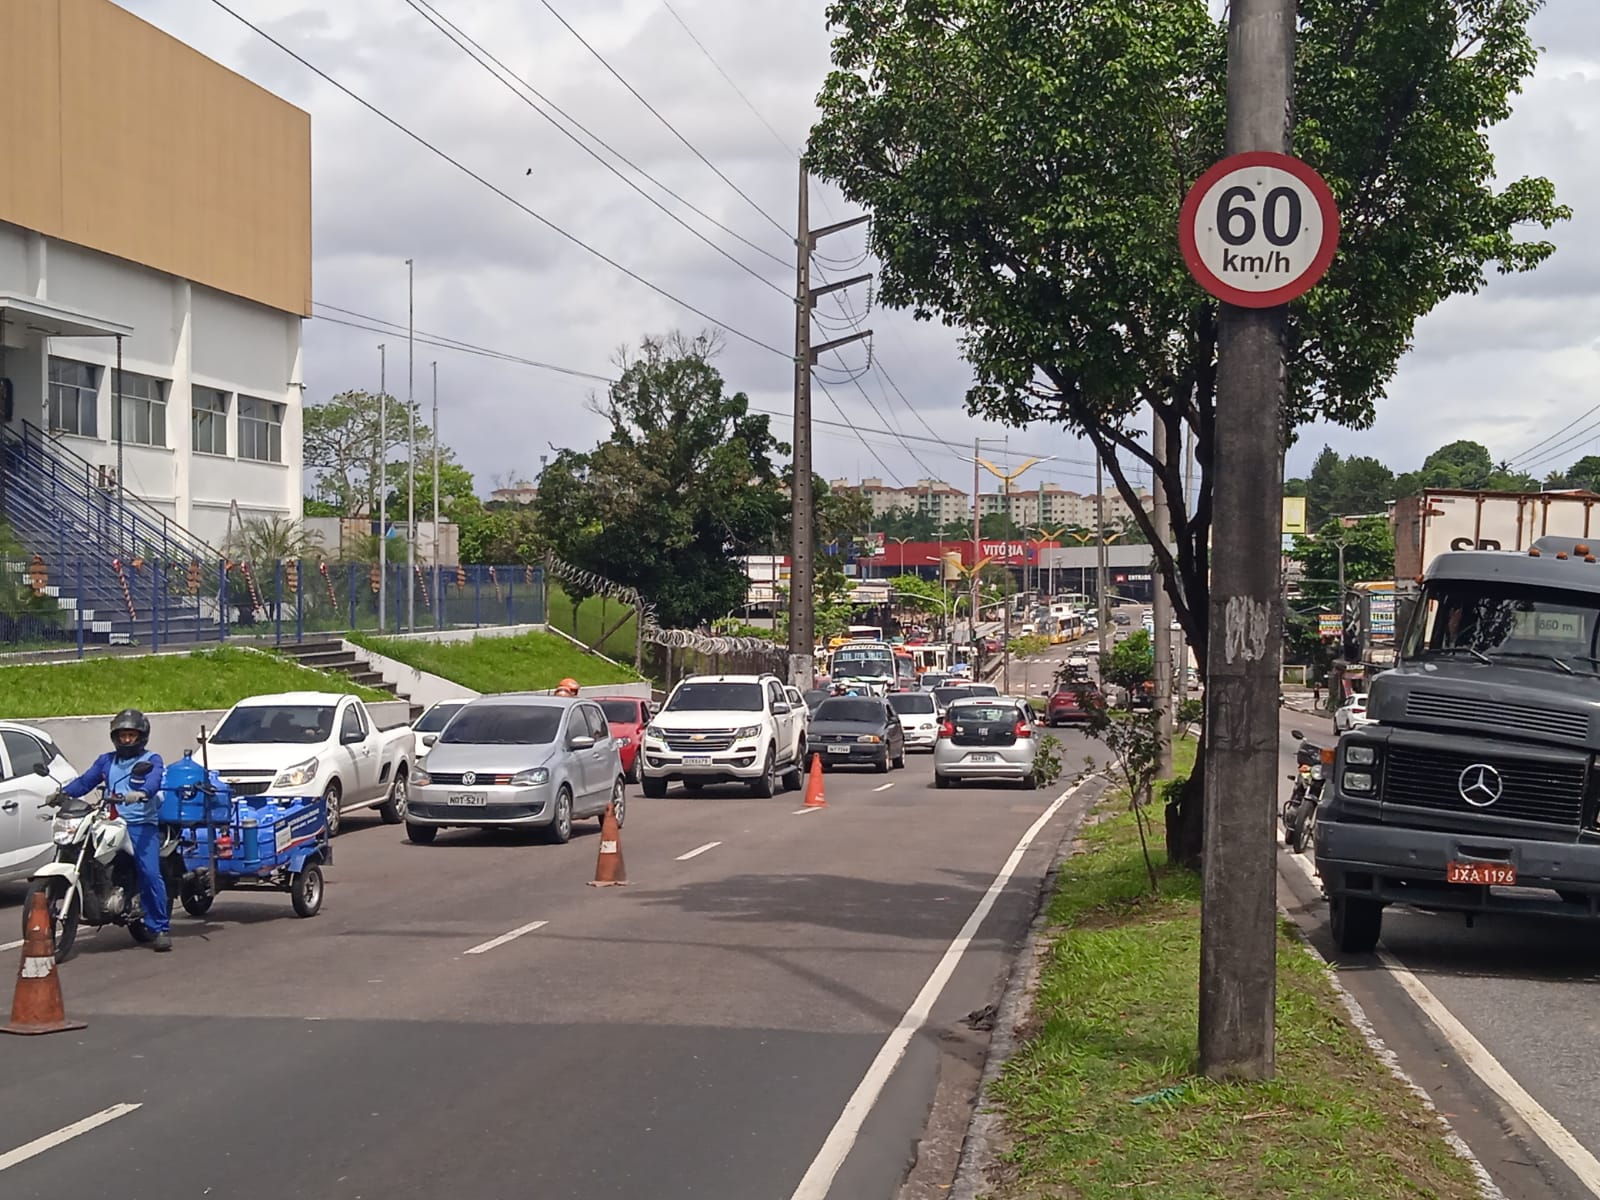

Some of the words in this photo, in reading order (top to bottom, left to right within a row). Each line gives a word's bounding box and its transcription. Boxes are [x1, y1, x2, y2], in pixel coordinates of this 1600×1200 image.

[1216, 185, 1302, 247] 60
[1222, 248, 1290, 273] km/h
[983, 542, 1024, 557] VITÓRIA
[1451, 869, 1480, 882] JXA
[1483, 869, 1514, 882] 1196
